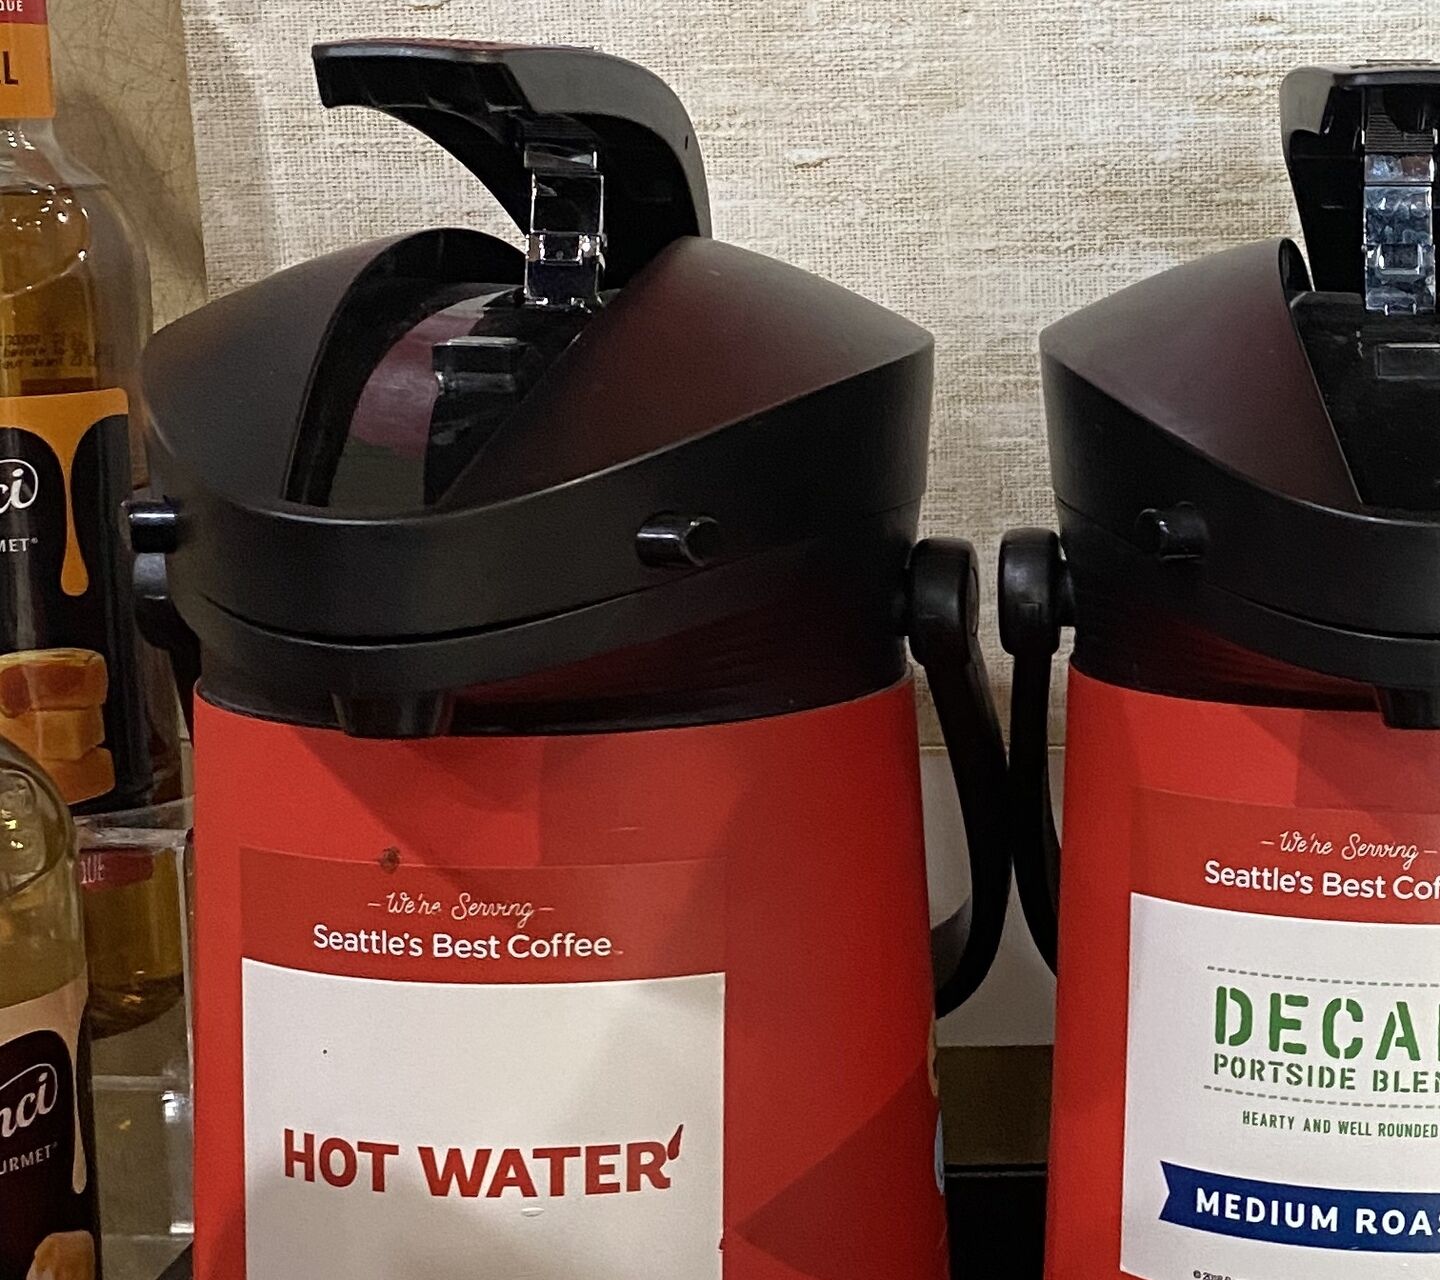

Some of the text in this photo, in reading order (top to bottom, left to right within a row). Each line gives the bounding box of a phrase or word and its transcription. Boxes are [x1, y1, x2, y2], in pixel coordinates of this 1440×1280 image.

[1279, 831, 1419, 870] We're Serving
[1205, 860, 1314, 894] Seattle's
[1322, 871, 1386, 898] Best
[385, 891, 534, 928] We're Serving
[313, 924, 612, 958] Seattle's Best Coffee
[1214, 1053, 1356, 1090] PORTSIDE
[1243, 1110, 1438, 1138] HEARTY AND WELL ROUNDED
[284, 1128, 676, 1198] HOT WATER
[1196, 1188, 1338, 1232] MEDIUM
